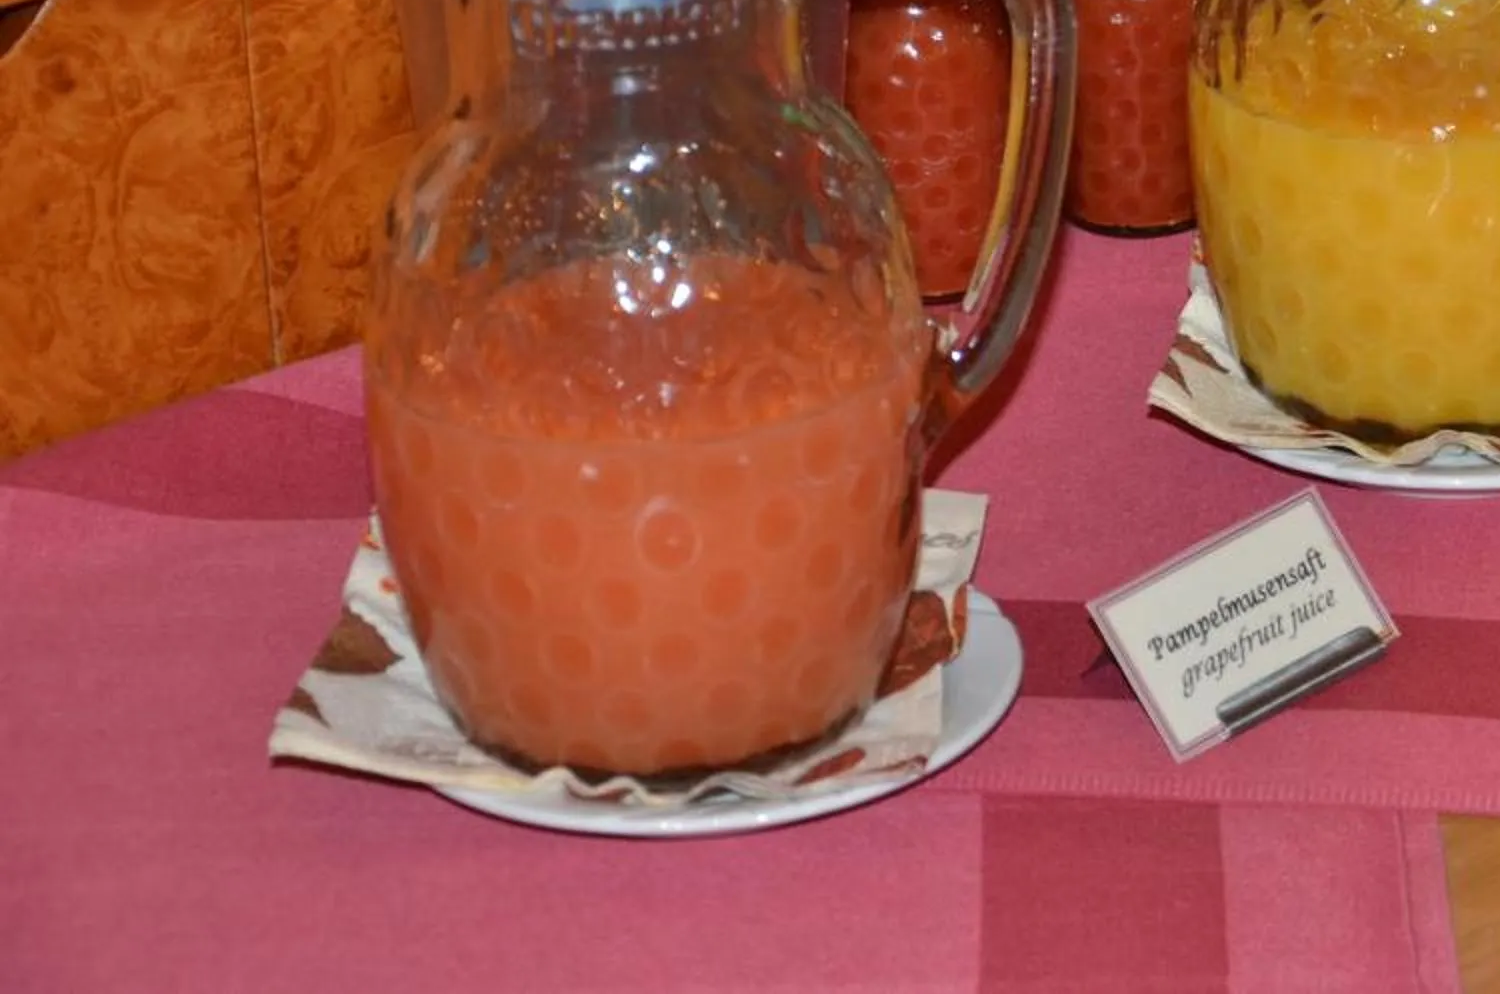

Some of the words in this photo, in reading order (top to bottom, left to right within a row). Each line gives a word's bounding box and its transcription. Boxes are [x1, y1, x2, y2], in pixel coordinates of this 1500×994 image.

[1147, 547, 1327, 661] Pampelmusensaft
[1180, 614, 1286, 699] grapefruit
[1289, 588, 1335, 639] juice
